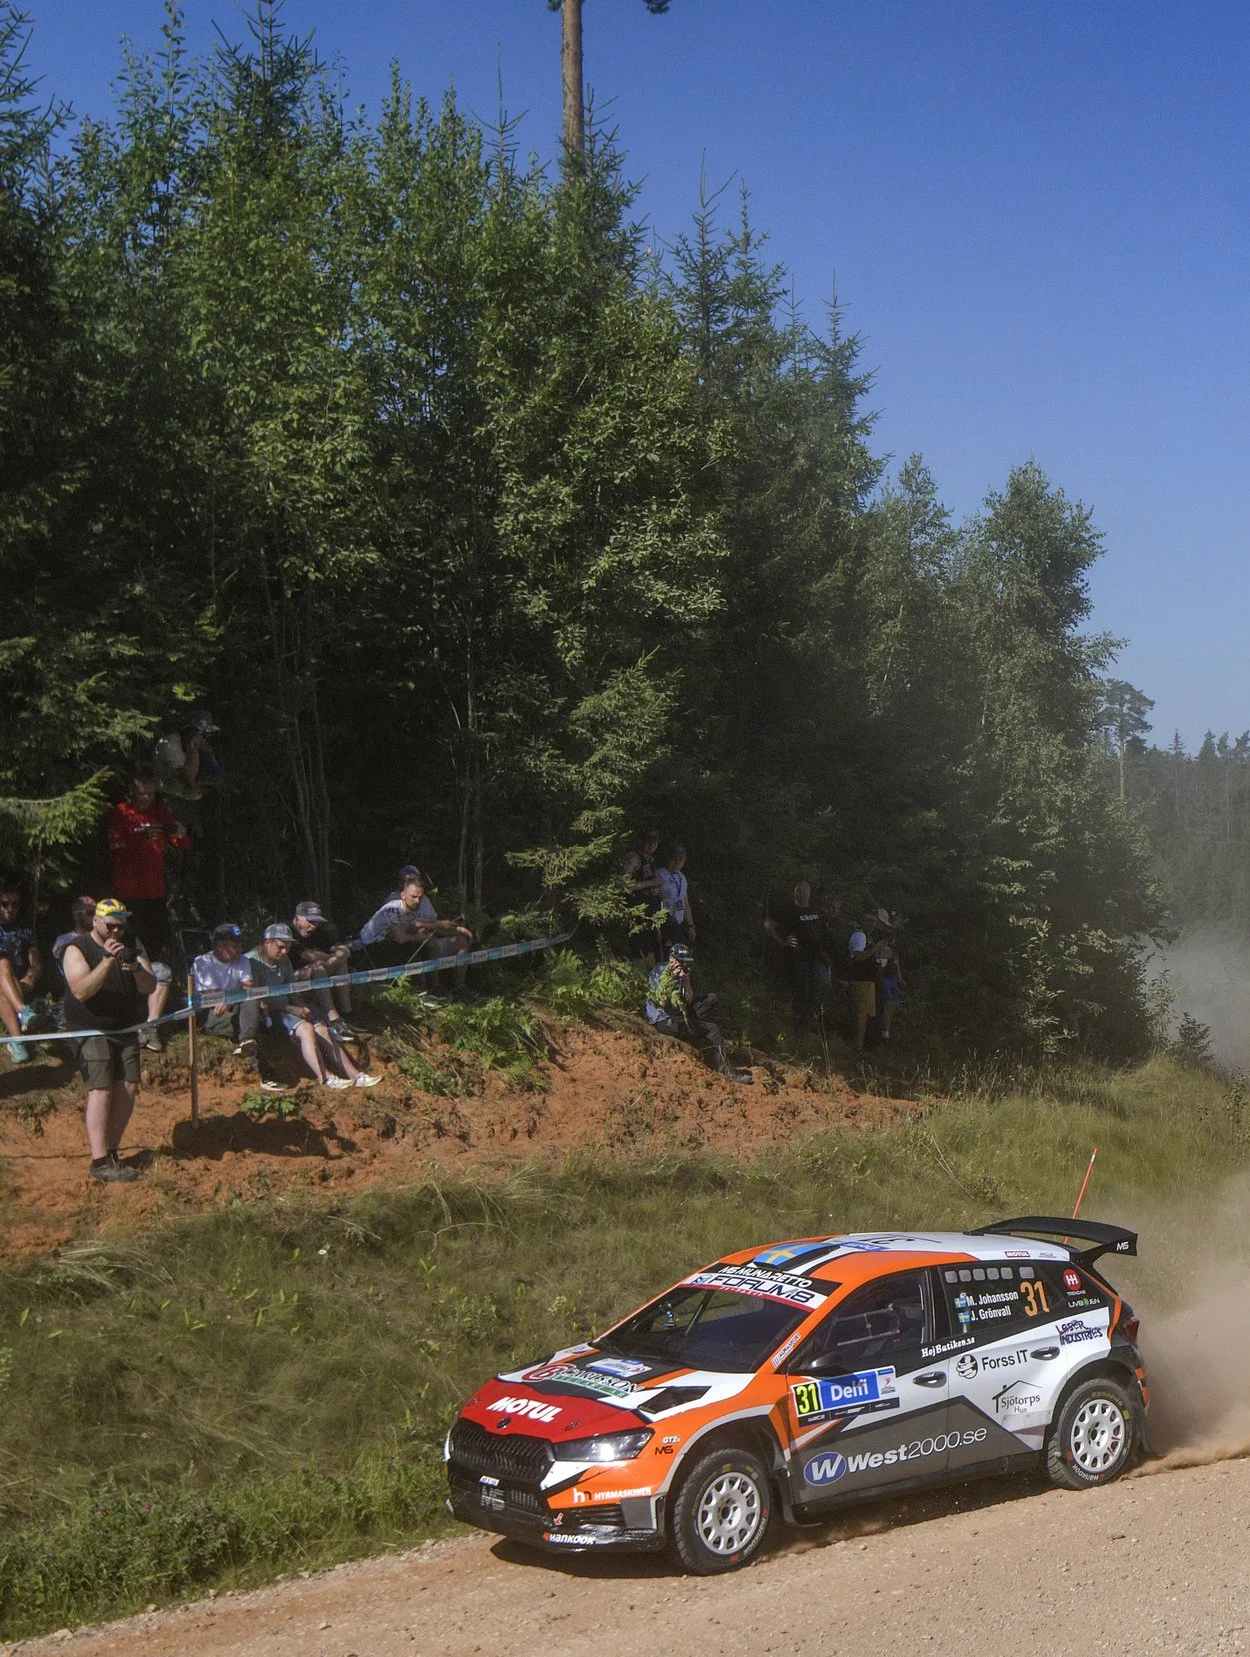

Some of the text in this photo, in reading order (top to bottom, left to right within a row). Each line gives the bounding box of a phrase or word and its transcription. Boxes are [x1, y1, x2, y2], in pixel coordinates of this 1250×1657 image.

[708, 1275, 817, 1304] FORUM8
[966, 1291, 1019, 1307] M. Johansson
[1020, 1280, 1051, 1317] 31
[971, 1304, 1012, 1322] J. Grönvall
[921, 1337, 976, 1358] HojBatiken.se
[980, 1349, 1028, 1371] Forss IT
[796, 1378, 869, 1413] 31 Delfi
[1001, 1395, 1041, 1411] Sjötorps
[486, 1396, 564, 1424] MOTUL
[1014, 1406, 1028, 1414] Hus
[848, 1426, 988, 1474] West2000.se
